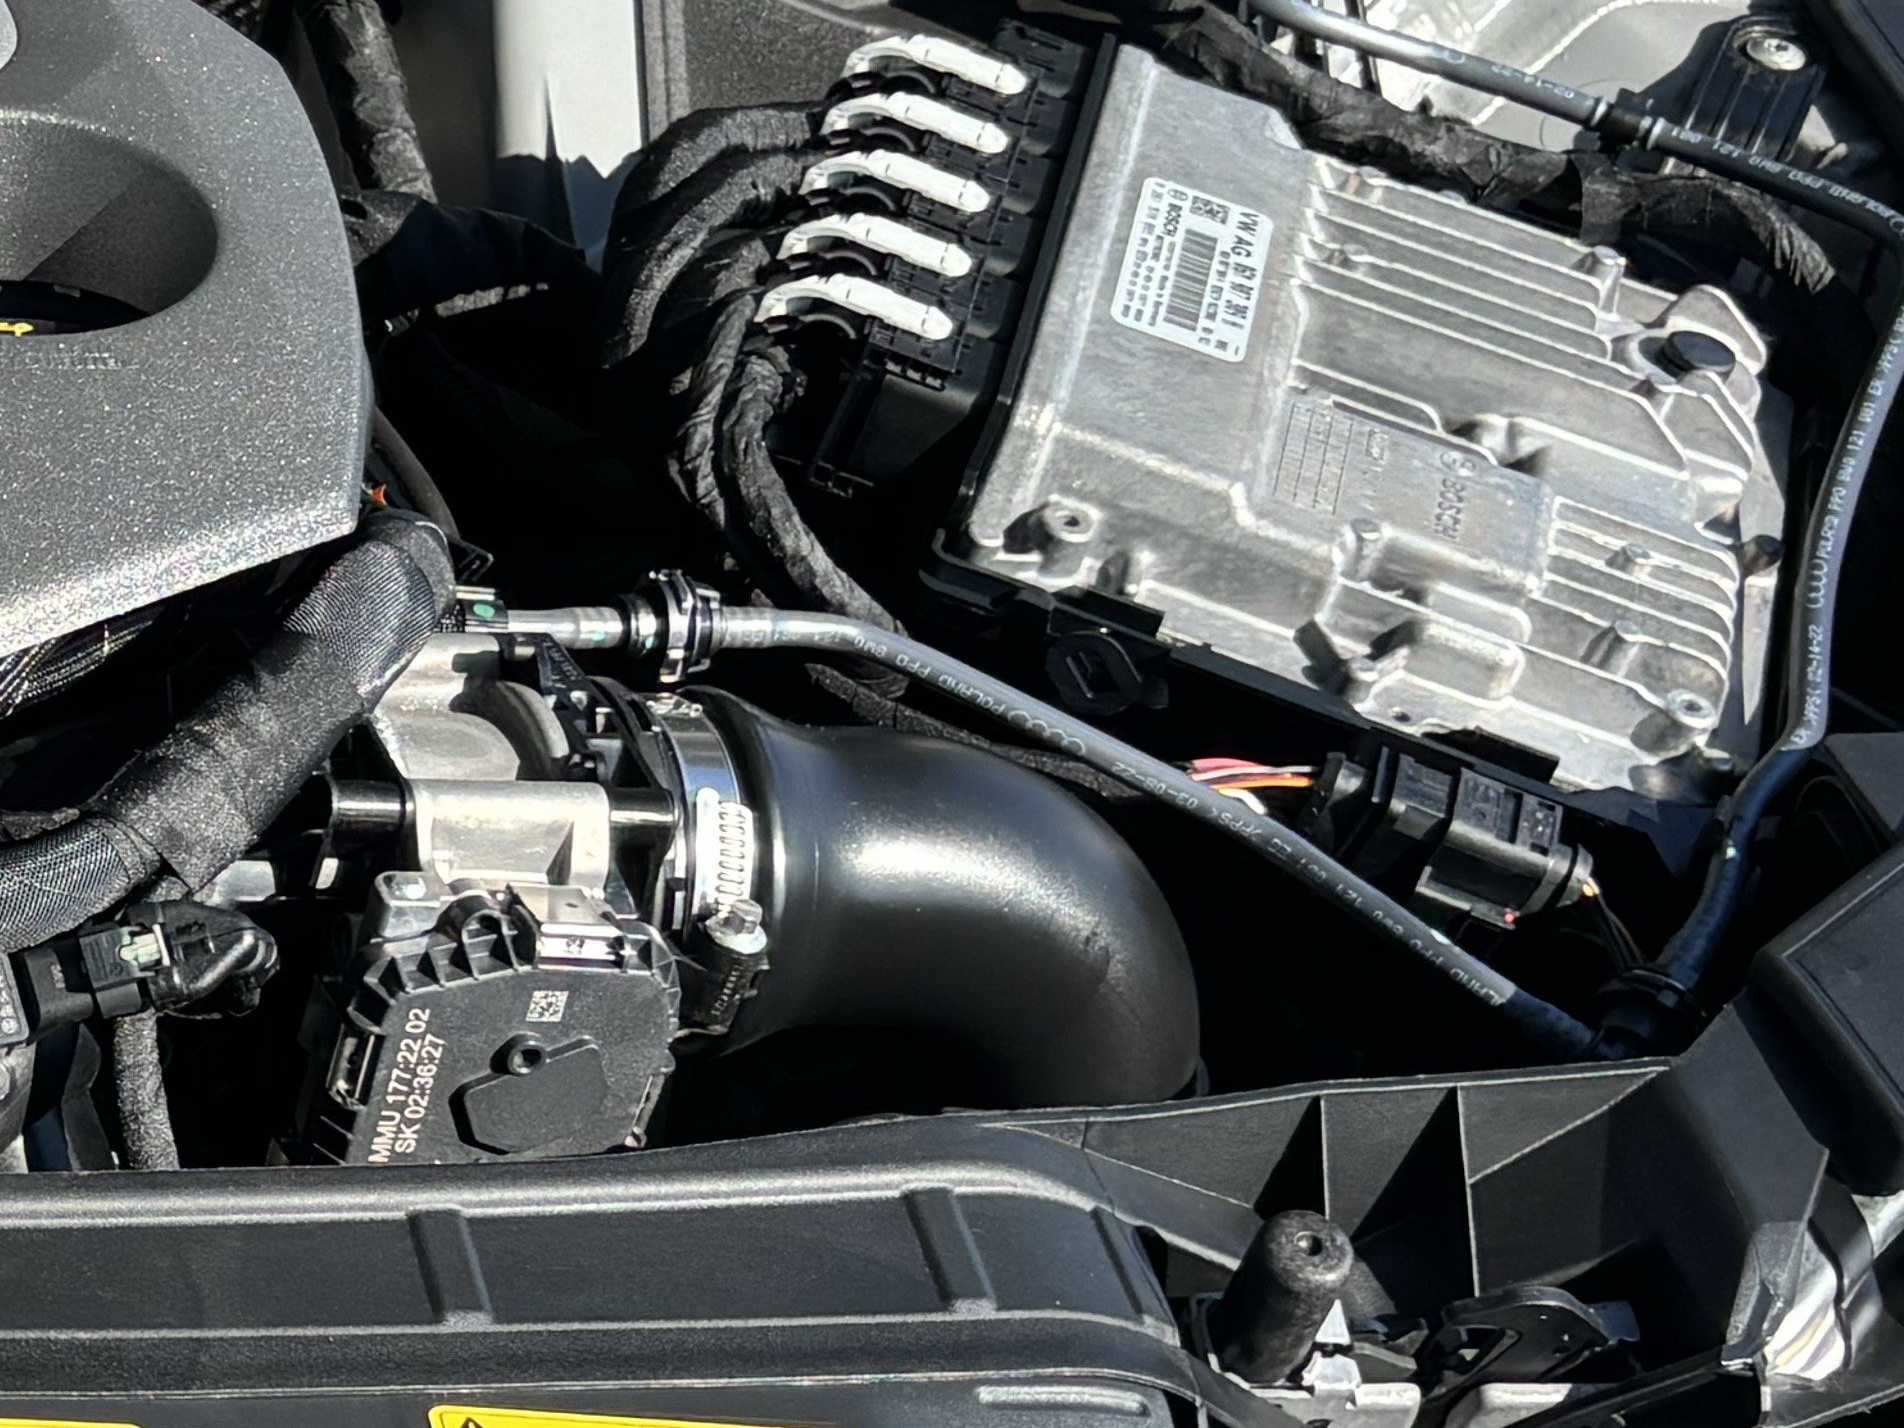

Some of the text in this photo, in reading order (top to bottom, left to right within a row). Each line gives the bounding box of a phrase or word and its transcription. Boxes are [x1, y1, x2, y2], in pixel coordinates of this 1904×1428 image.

[1165, 202, 1183, 237] BOSCH
[1235, 210, 1260, 236] VW
[1230, 235, 1252, 259] AG
[1434, 477, 1466, 541] BOSCH
[937, 672, 1007, 716] POLAND
[368, 1008, 431, 1163] MMU 177:22 02
[394, 1033, 448, 1154] SK 02:36:27
